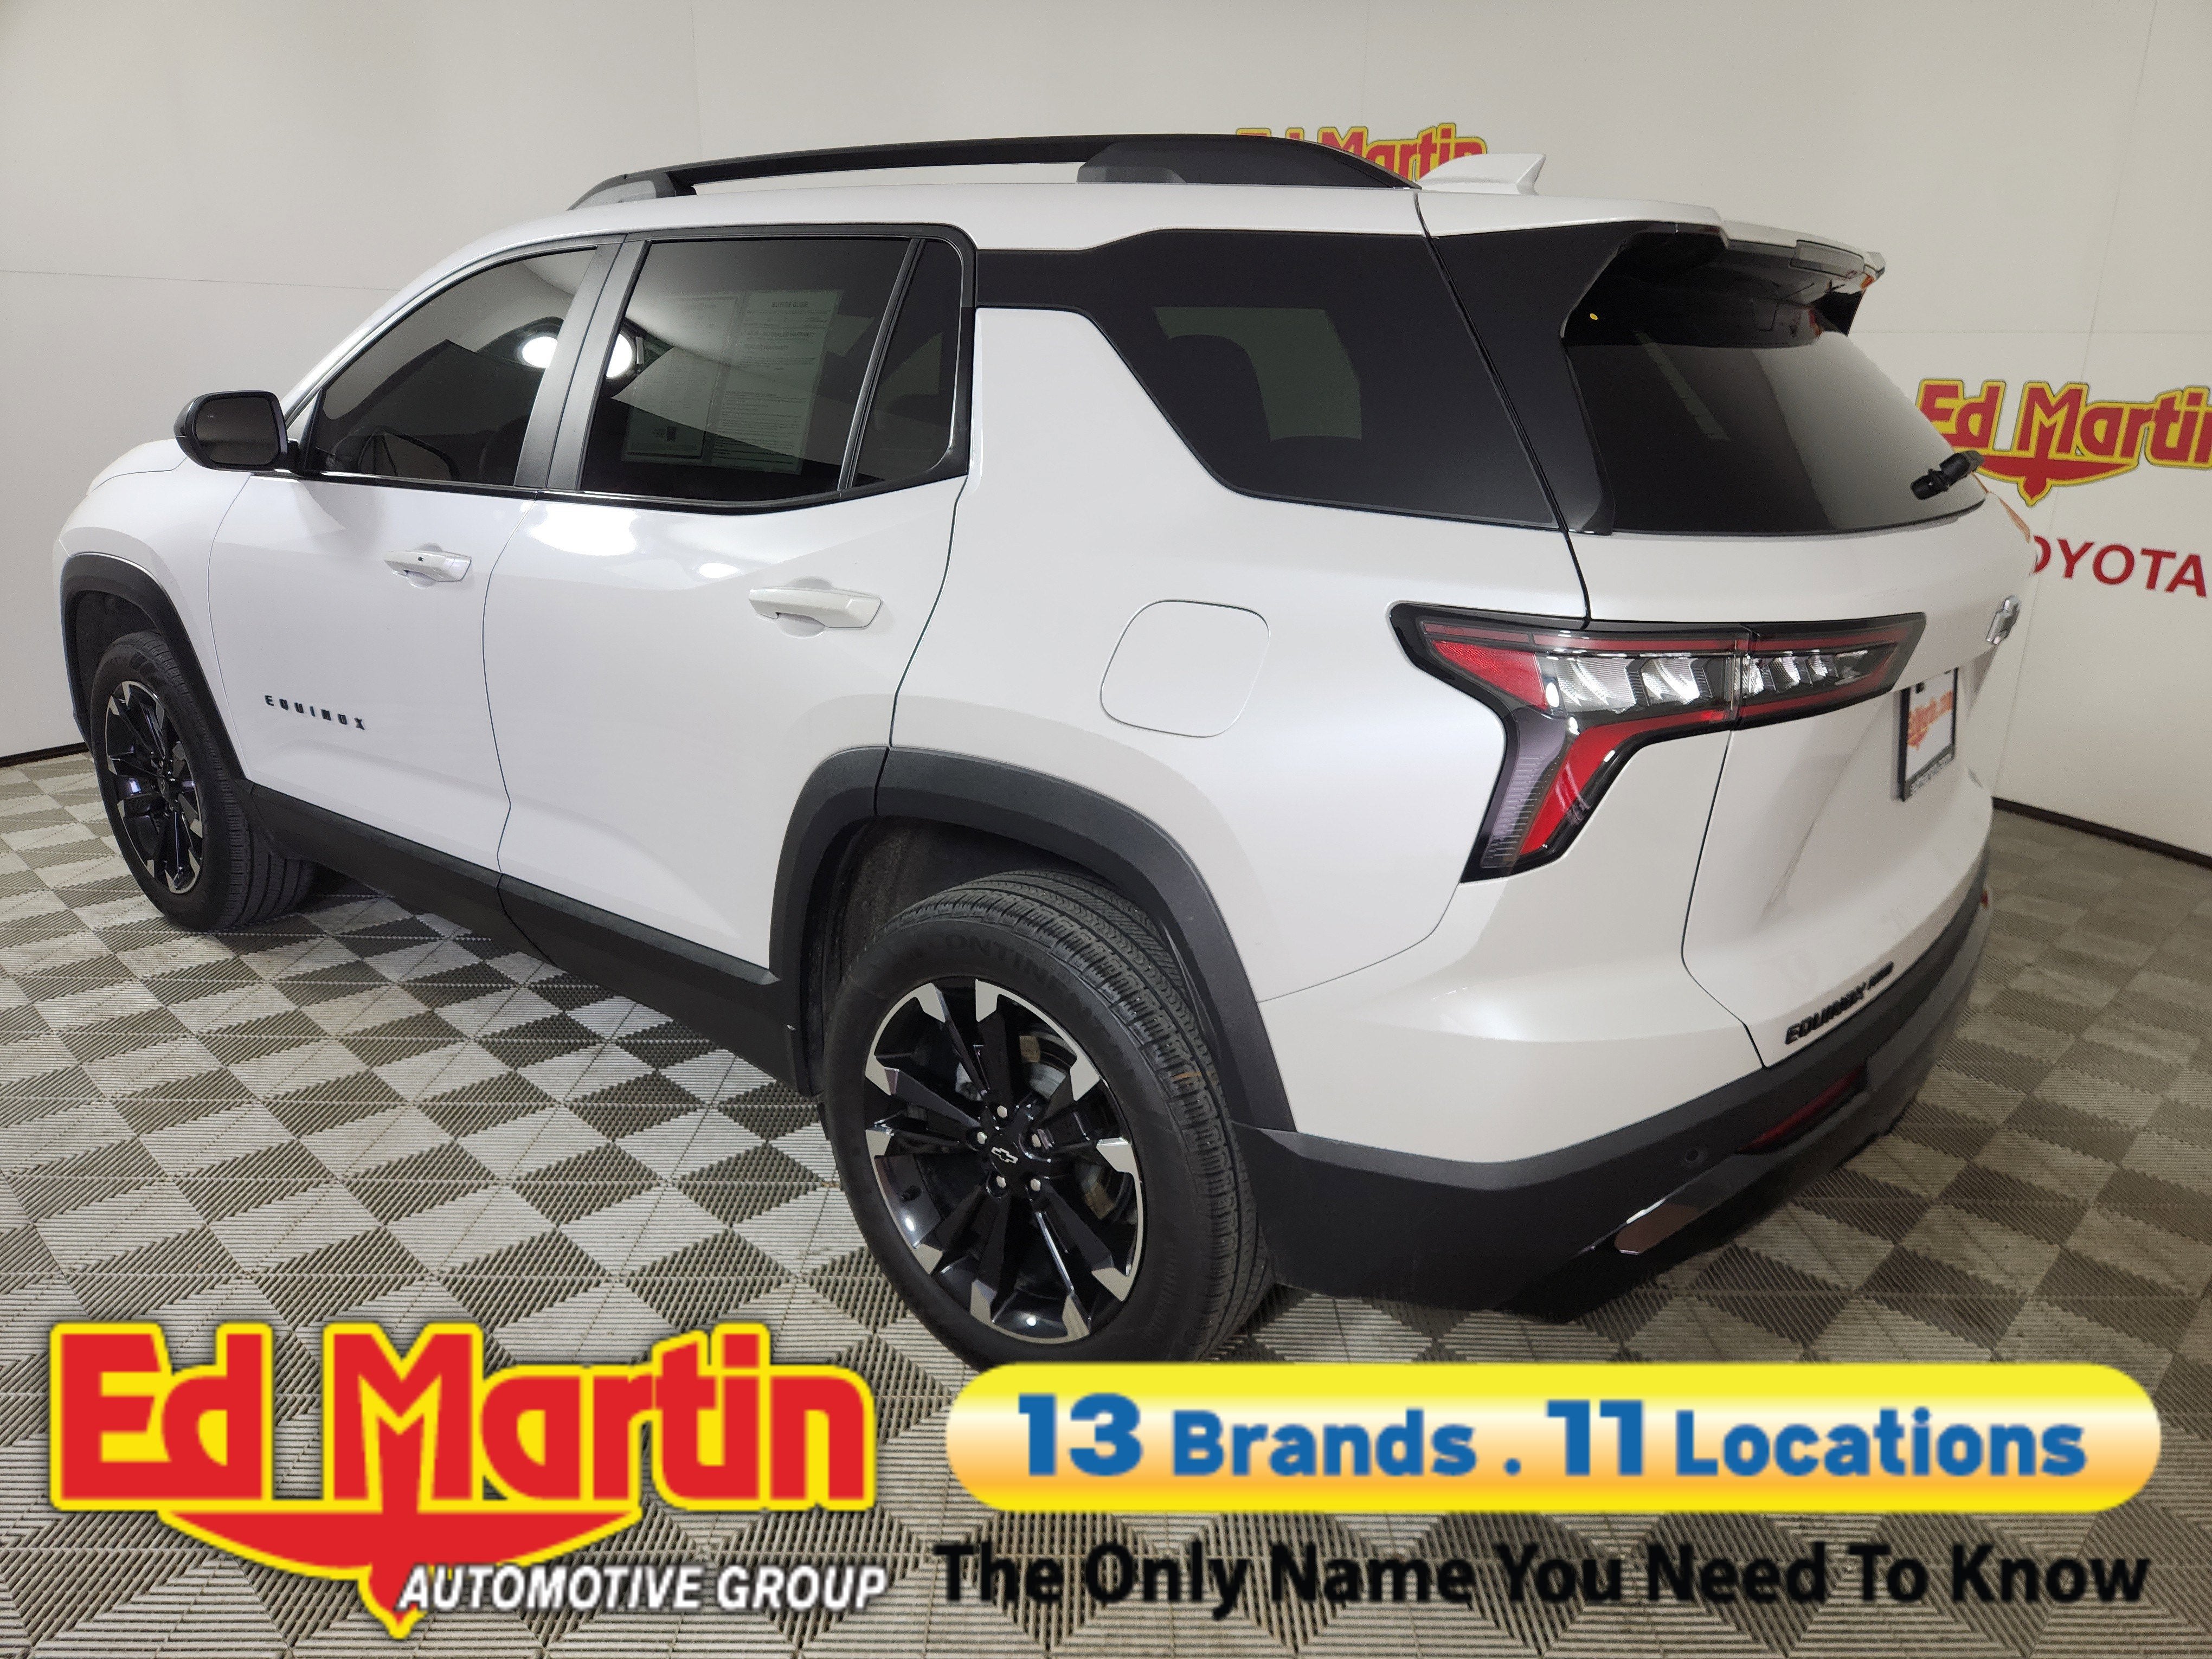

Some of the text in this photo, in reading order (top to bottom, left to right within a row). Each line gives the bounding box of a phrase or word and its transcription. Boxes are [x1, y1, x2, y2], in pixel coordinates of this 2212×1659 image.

[1915, 379, 2212, 470] Ed Marti
[264, 695, 365, 730] EQUINOX
